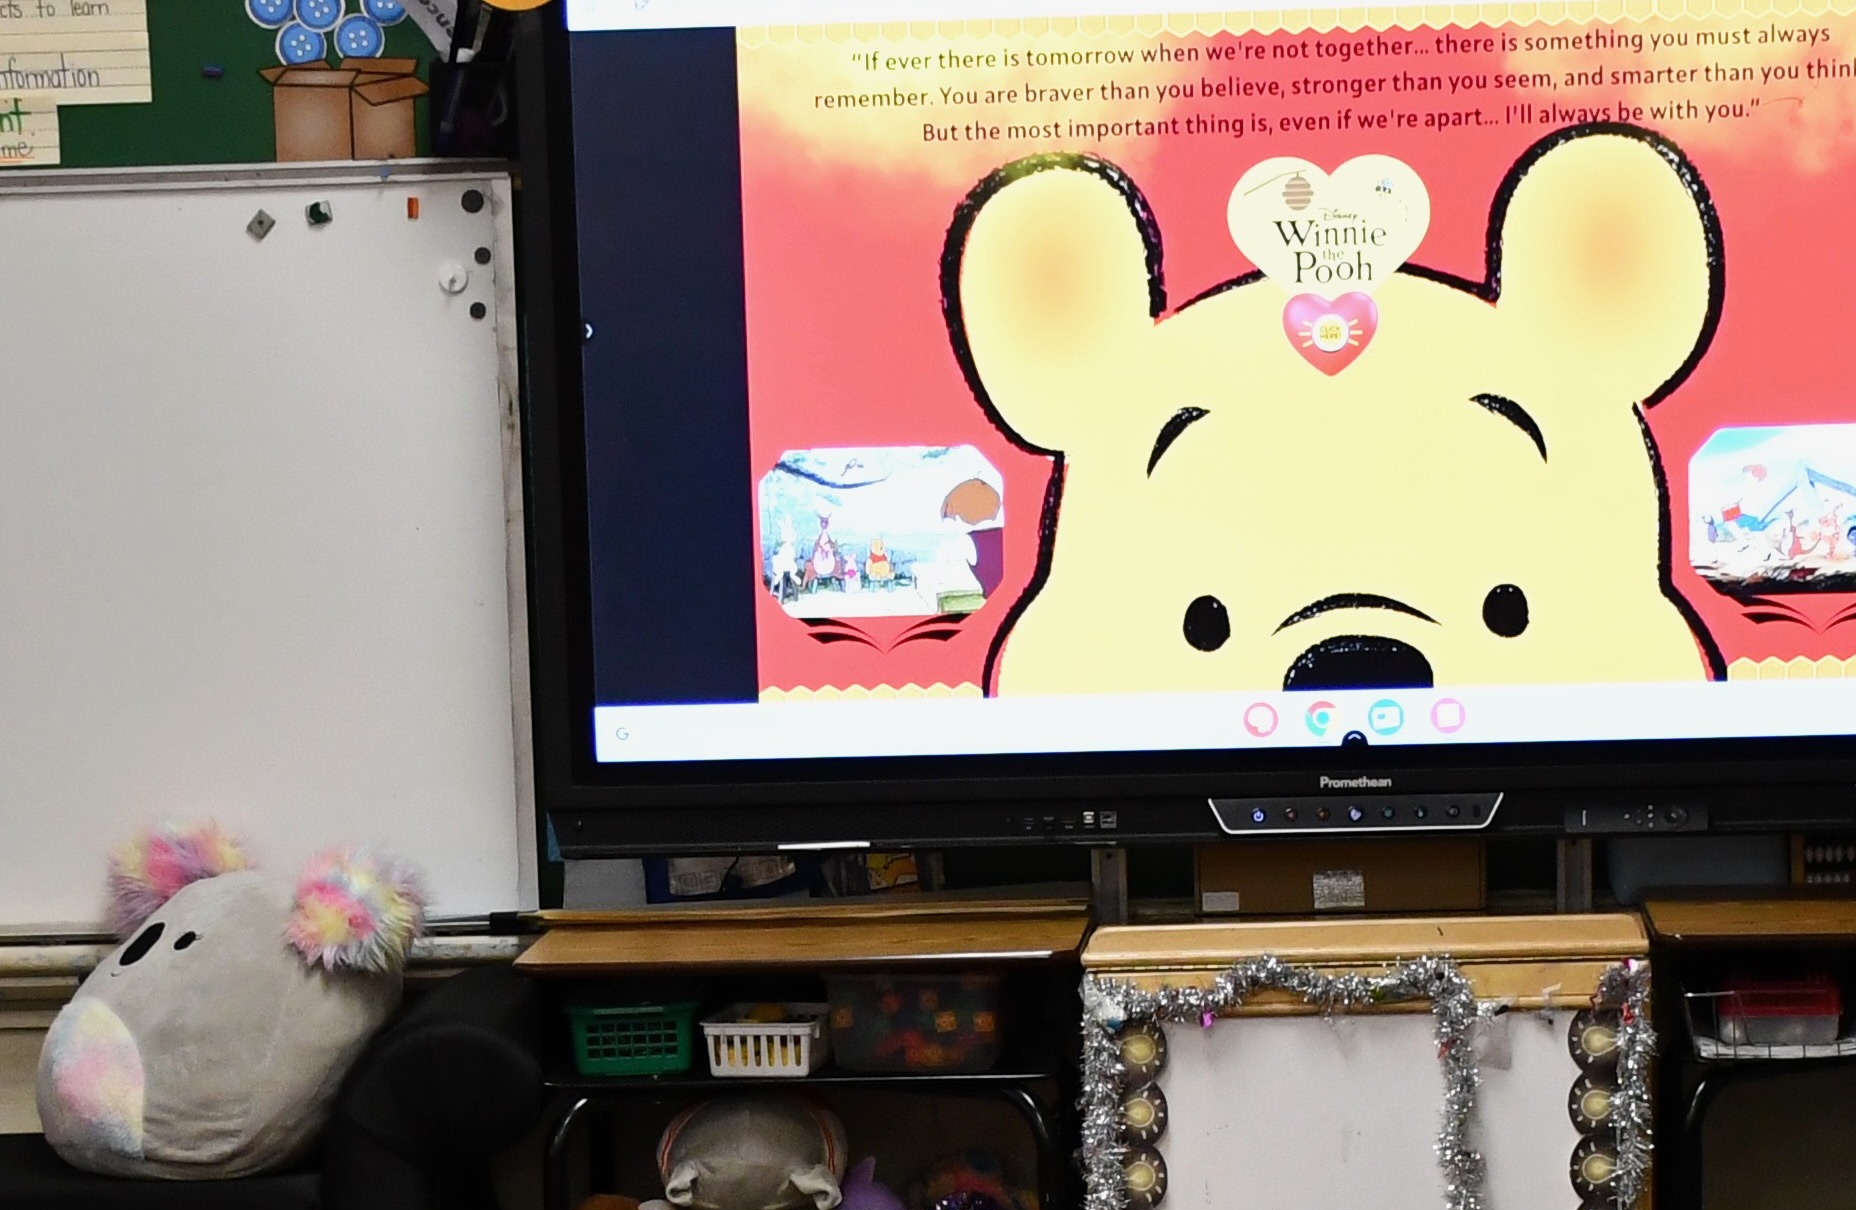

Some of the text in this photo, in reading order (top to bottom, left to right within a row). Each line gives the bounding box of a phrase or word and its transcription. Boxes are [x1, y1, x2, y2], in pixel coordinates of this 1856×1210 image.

[36, 1, 55, 18] to
[71, 0, 109, 17] learn
[885, 55, 932, 71] ever
[938, 49, 997, 70] there
[1003, 48, 1020, 68] is
[1027, 48, 1134, 67] tomorrow
[1141, 42, 1199, 63] when
[1206, 41, 1266, 60] we're
[1272, 41, 1310, 60] not
[1315, 35, 1430, 62] together...
[1435, 33, 1495, 54] there
[1500, 32, 1518, 52] is
[1524, 28, 1643, 53] something
[1650, 33, 1689, 52] you
[1696, 27, 1751, 46] must
[1758, 23, 1830, 48] always
[814, 87, 934, 109] remember.
[939, 86, 978, 105] You
[984, 87, 1019, 104] are
[1025, 82, 1094, 102] braver
[1100, 80, 1150, 100] than
[1156, 83, 1195, 104] you
[1201, 76, 1285, 100] believe,
[1291, 74, 1387, 98] stronger
[1393, 71, 1442, 92] than
[1448, 73, 1488, 95] you
[1494, 71, 1558, 91] seem,
[1564, 65, 1604, 87] and
[1610, 66, 1698, 85] smarter
[1705, 62, 1754, 83] than
[1760, 65, 1799, 85] you
[922, 123, 958, 142] But
[965, 120, 1000, 140] the
[1007, 119, 1062, 138] most
[1069, 117, 1179, 142] important
[1185, 113, 1244, 138] thing
[1251, 113, 1273, 136] is,
[1279, 113, 1330, 131] even
[1337, 108, 1352, 130] if
[1357, 108, 1418, 129] we're
[1424, 108, 1499, 132] apart...
[1505, 104, 1532, 124] I'll
[1539, 101, 1611, 124] always
[1618, 100, 1643, 122] be
[1650, 99, 1698, 120] with
[1272, 218, 1387, 247] Winnie
[1293, 250, 1373, 284] Pooh
[1322, 249, 1345, 261] the
[1319, 775, 1392, 789] Promethean
